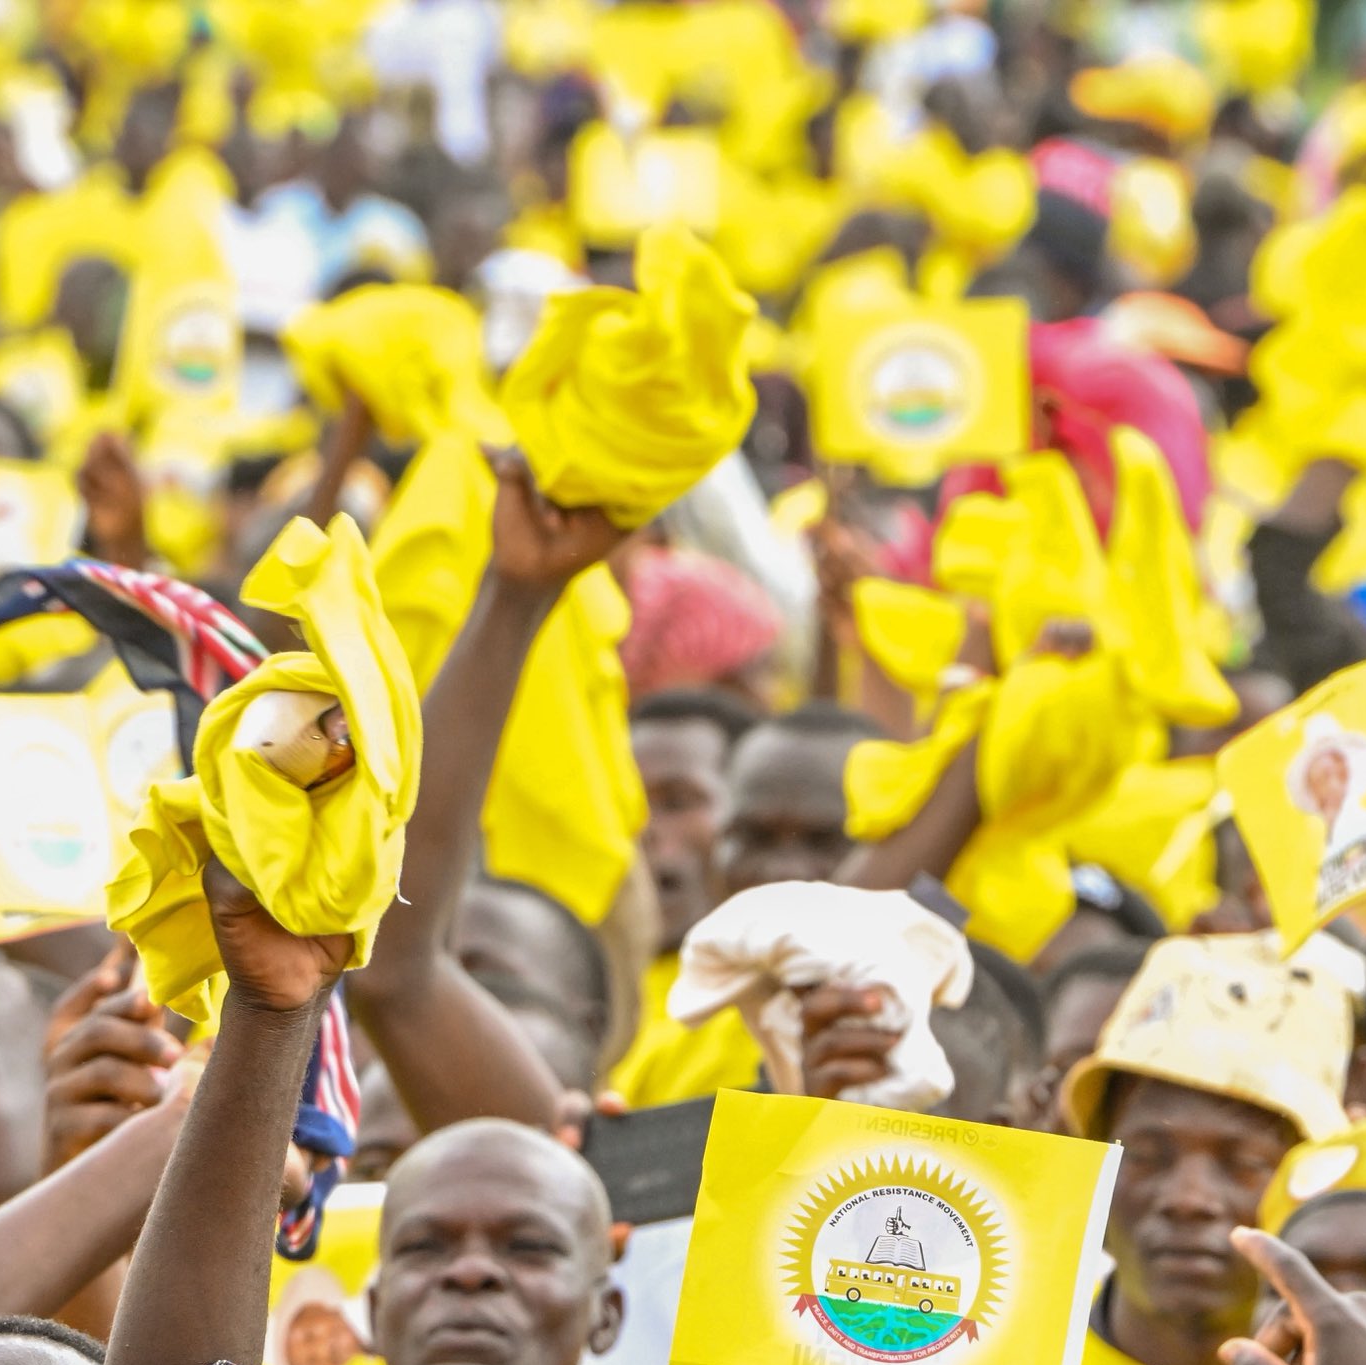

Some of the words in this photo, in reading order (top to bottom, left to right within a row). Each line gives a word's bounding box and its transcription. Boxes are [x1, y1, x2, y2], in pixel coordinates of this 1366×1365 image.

[829, 1193, 870, 1228] NATIONAL
[872, 1187, 935, 1204] RESISTANCE
[936, 1201, 974, 1248] MOVEMENT
[827, 1325, 844, 1342] UNITY
[842, 1339, 857, 1351] AND
[856, 1346, 913, 1361] TRANSFORMATION
[913, 1350, 928, 1360] FOR
[927, 1328, 964, 1355] PROSPERITY
